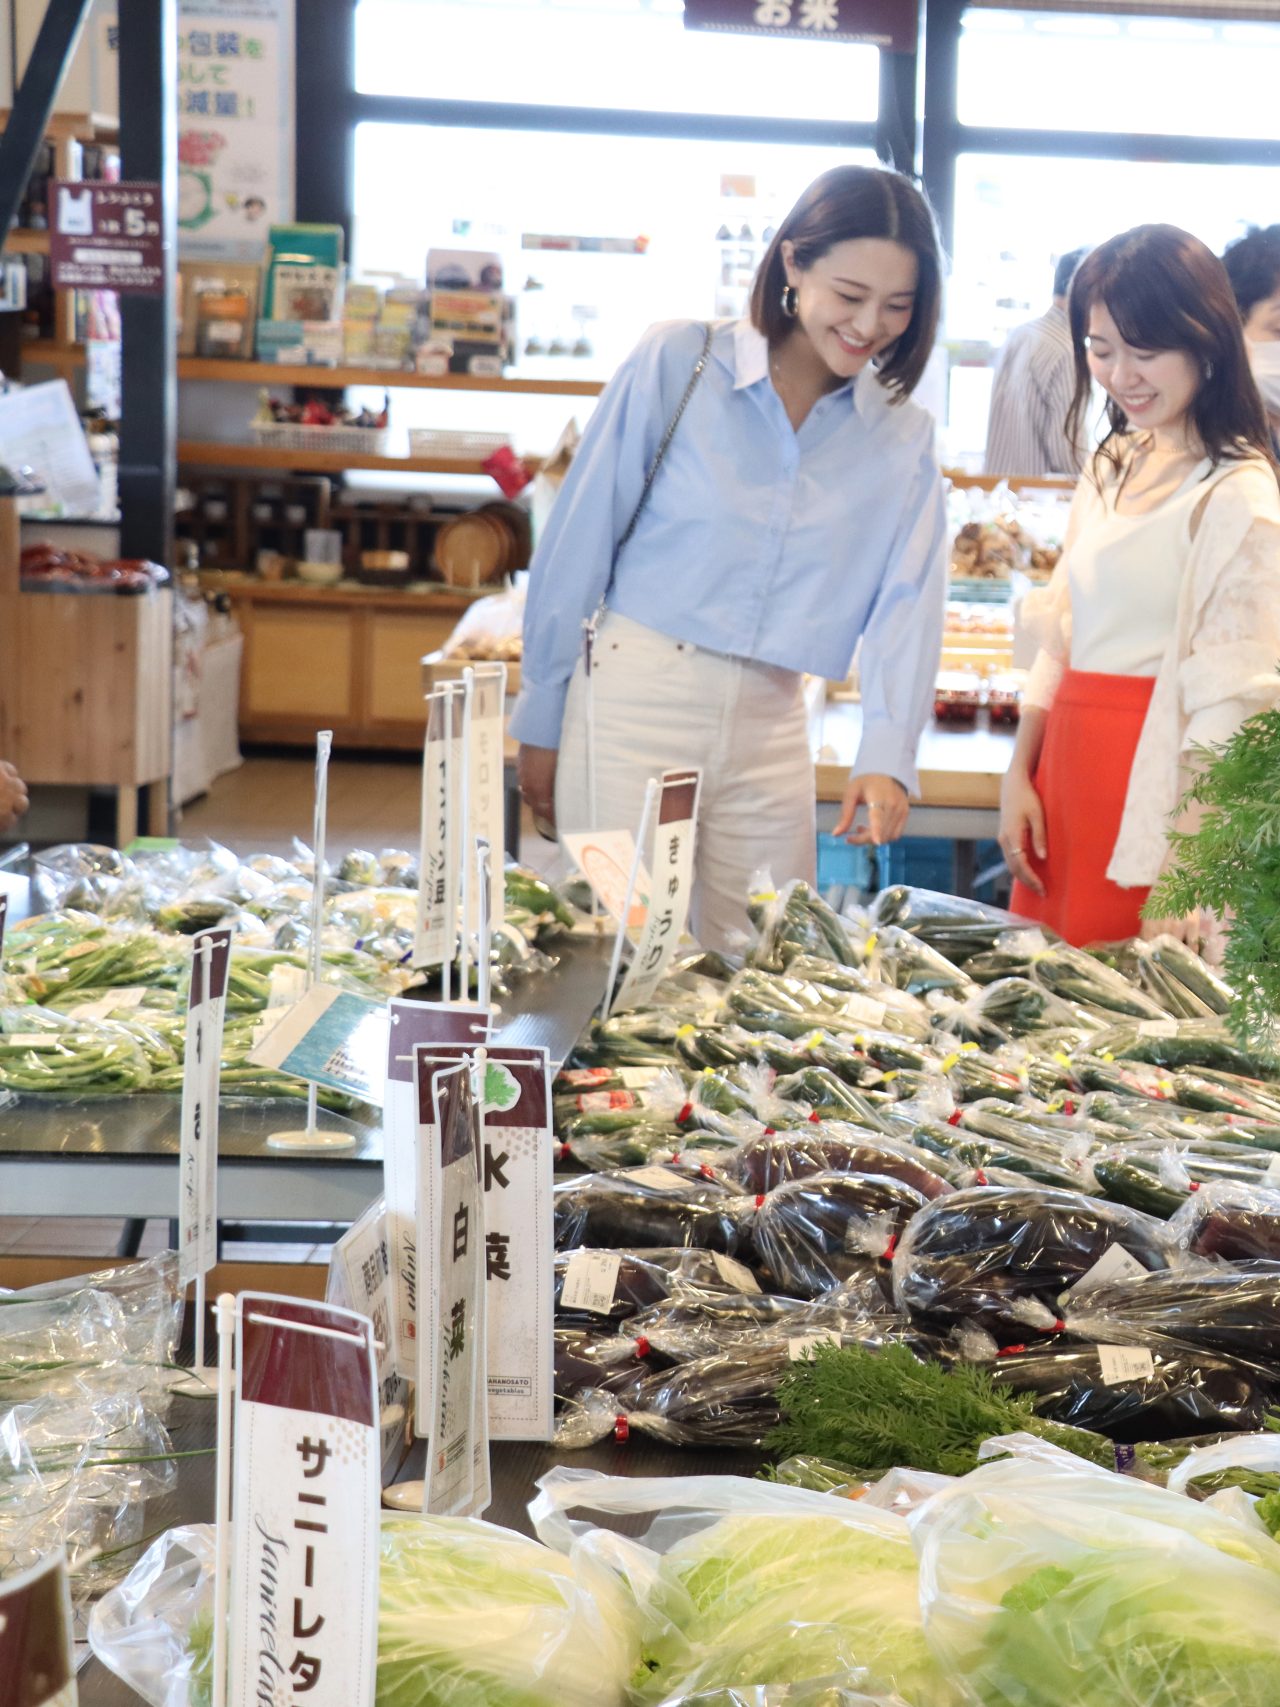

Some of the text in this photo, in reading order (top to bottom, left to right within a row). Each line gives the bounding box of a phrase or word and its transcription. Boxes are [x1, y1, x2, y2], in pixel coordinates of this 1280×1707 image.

[754, 0, 839, 31] お米
[647, 834, 680, 971] きゅうり
[450, 1201, 469, 1362] 白菜
[289, 1436, 332, 1706] サニーレタ
